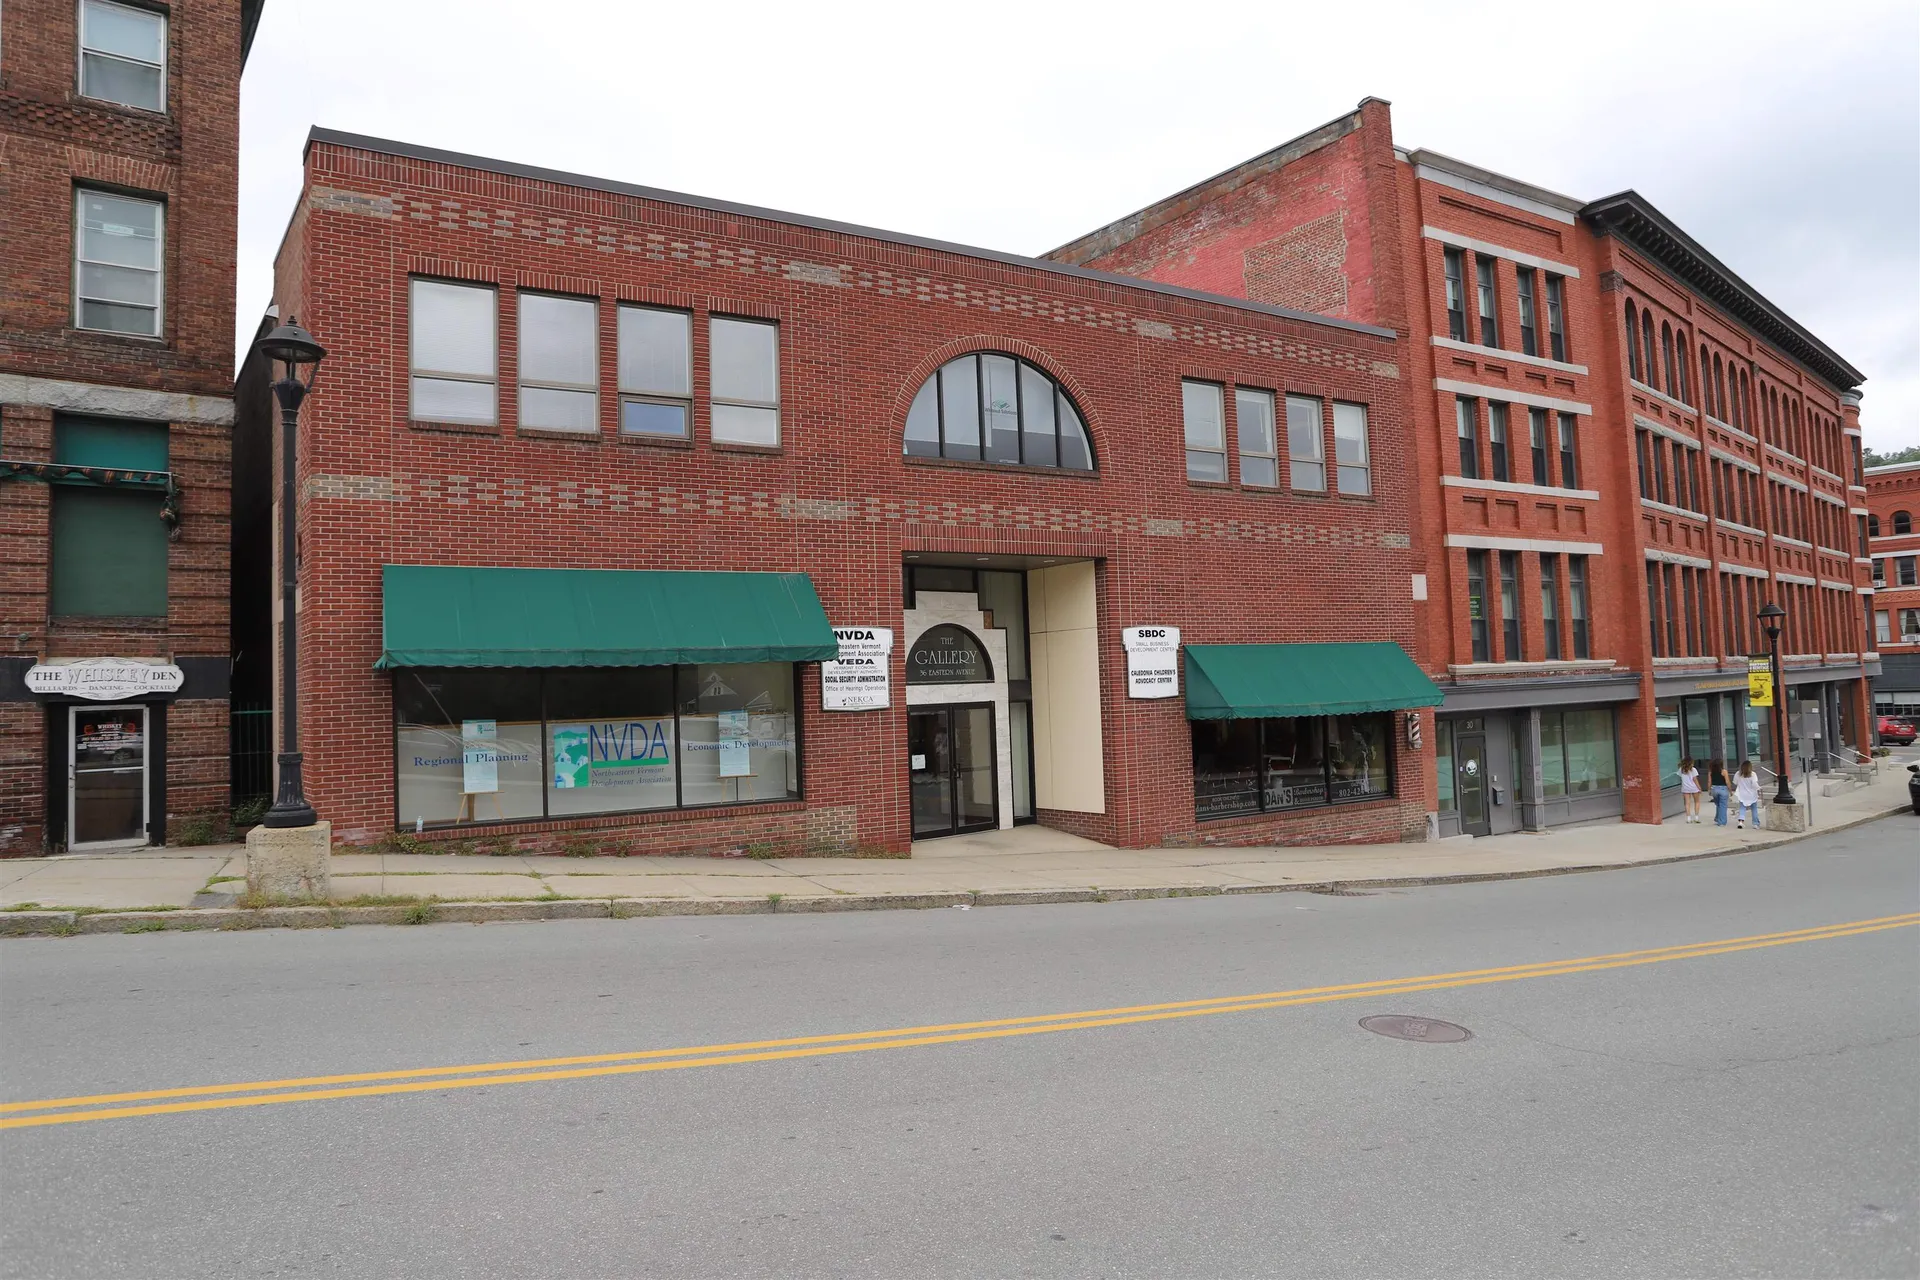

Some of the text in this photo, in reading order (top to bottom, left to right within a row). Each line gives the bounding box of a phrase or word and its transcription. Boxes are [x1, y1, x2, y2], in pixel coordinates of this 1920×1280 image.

[834, 630, 875, 640] NVDA
[1138, 630, 1166, 638] SBDC
[940, 637, 954, 645] THE
[914, 649, 978, 665] GALLERY
[33, 668, 177, 684] THE WHISKEY DEN
[920, 669, 927, 677] 36
[955, 668, 976, 676] AVENUE
[1131, 669, 1153, 677] CALEDONIA
[825, 675, 885, 683] SOCIAL SECURITY ADMINISTRATION
[1466, 720, 1474, 729] 30
[590, 722, 669, 762] NVDA
[687, 739, 790, 751] Economic Development
[414, 752, 529, 767] Regional Planning
[591, 767, 665, 778] Northeastern Vermont
[591, 778, 634, 788] Development
[1265, 789, 1292, 806] DAN'S
